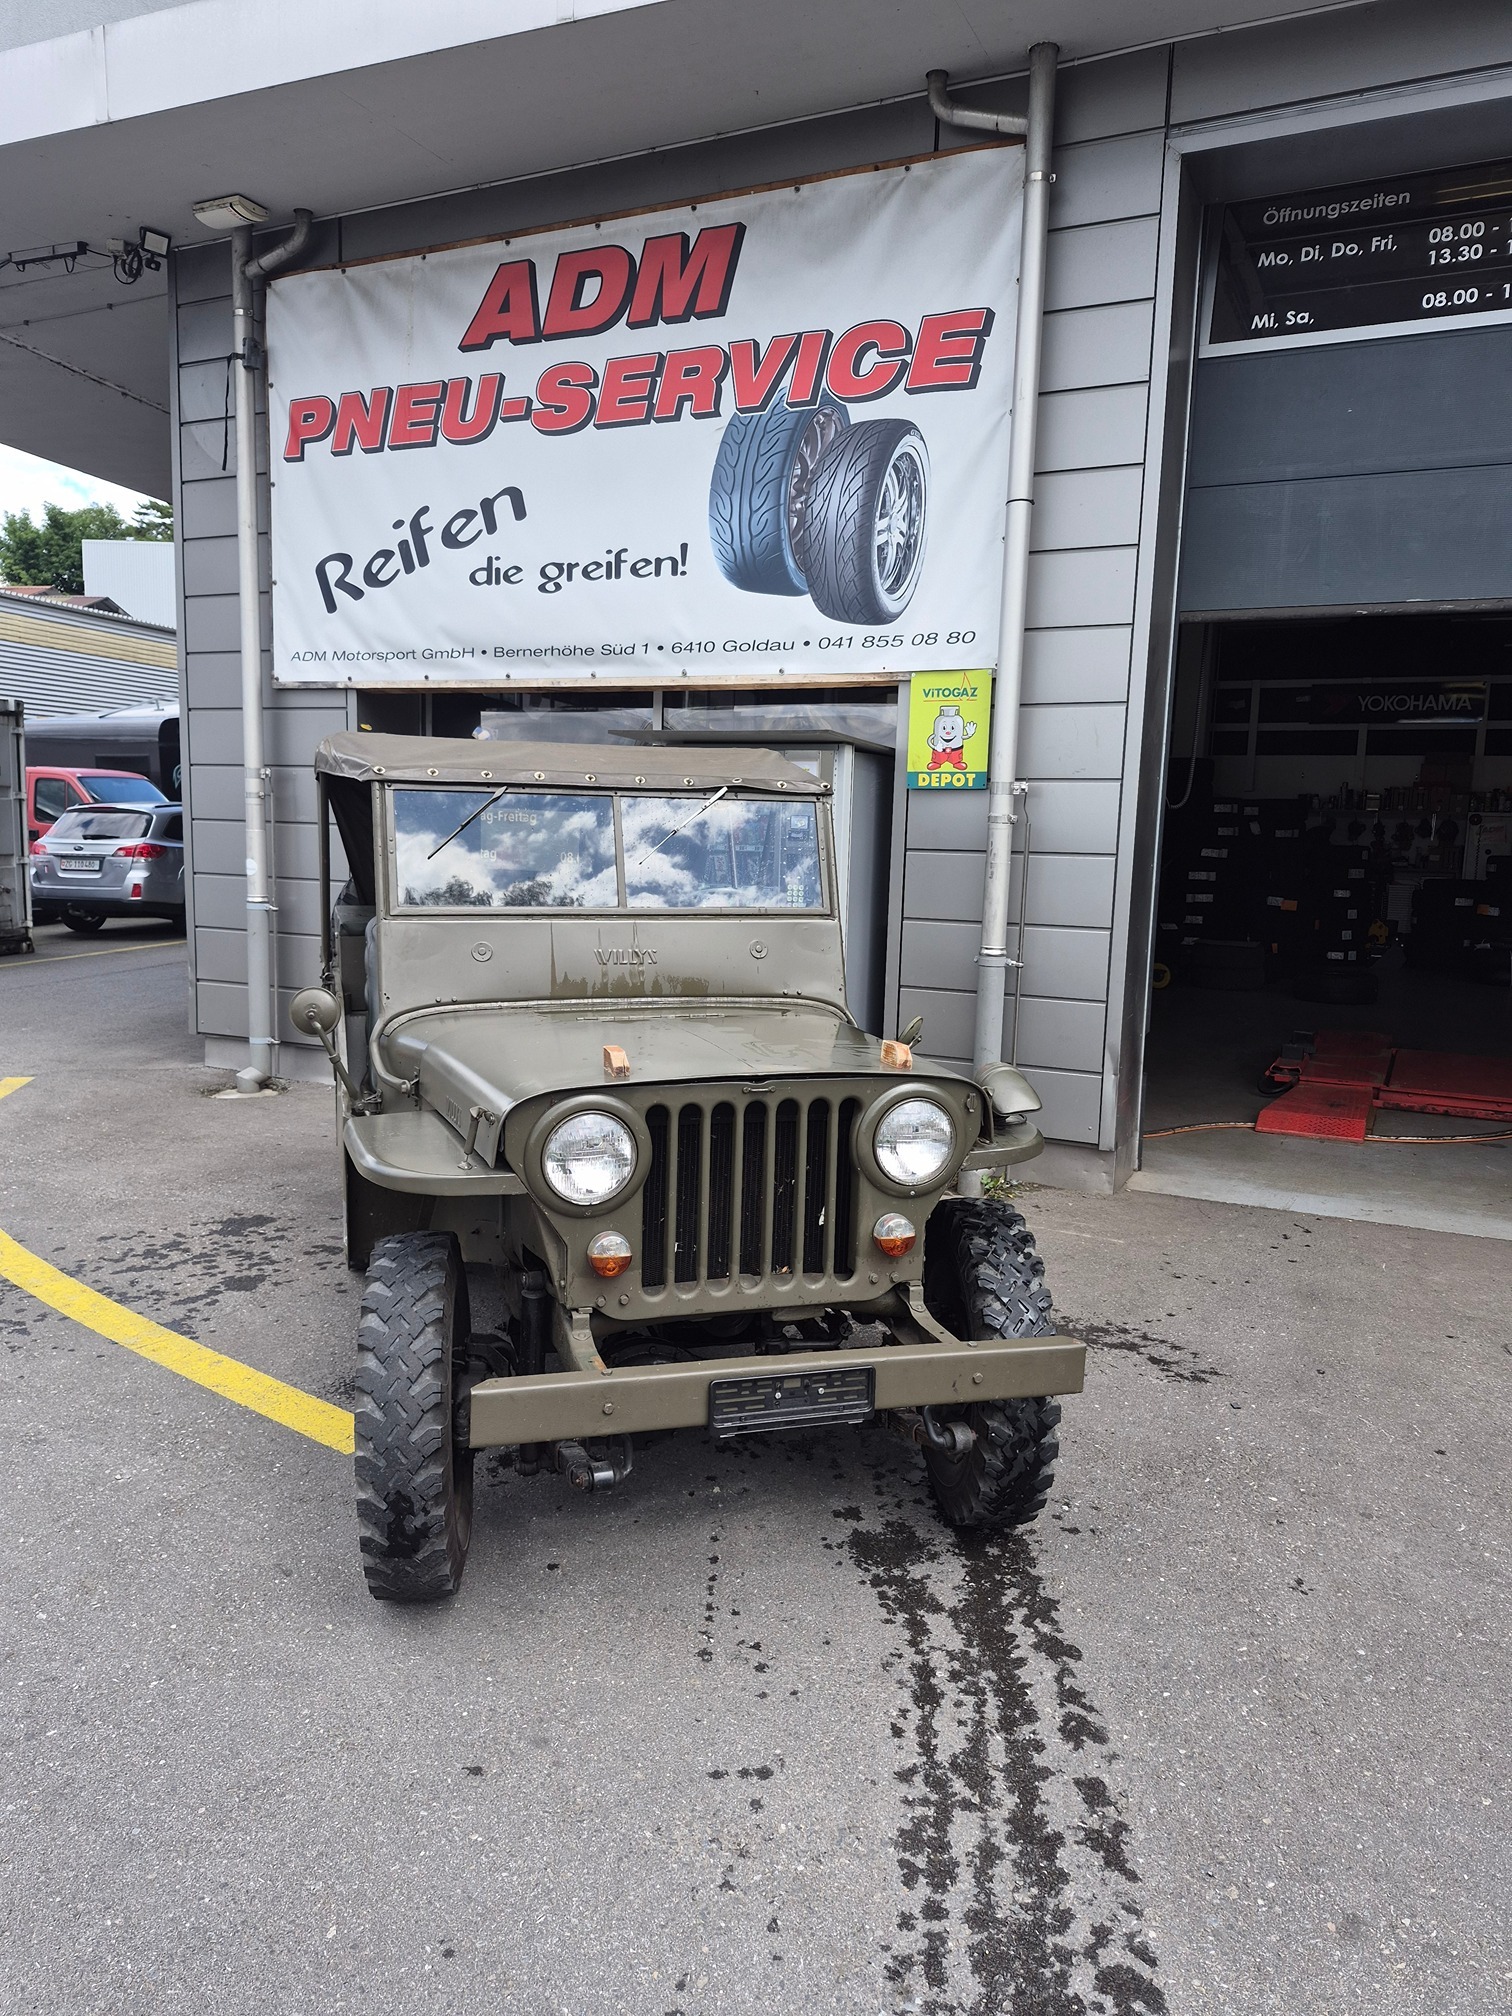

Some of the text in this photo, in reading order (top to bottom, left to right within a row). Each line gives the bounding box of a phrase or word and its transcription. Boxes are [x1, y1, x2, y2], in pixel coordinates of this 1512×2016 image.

[1263, 191, 1411, 225] Öffnungszeiten
[1428, 221, 1485, 244] 08.00
[1257, 234, 1397, 268] Mo, Di, Do, Fri,
[1428, 243, 1483, 265] 13.30
[458, 222, 747, 353] ADM
[1422, 287, 1479, 309] 08.00
[1251, 310, 1315, 329] Mi, Sa,
[283, 307, 996, 462] PNEU-SERVICE
[315, 486, 527, 614] Reifen
[469, 542, 688, 594] die greifen!
[290, 631, 976, 662] ADM Motorsport GmbH Bernerhöhe Süd 1 6410 Goldau 041 855 08 80
[1357, 694, 1473, 712] YOKOHAMA
[917, 773, 976, 787] DEPOT
[593, 949, 657, 965] WILLYS
